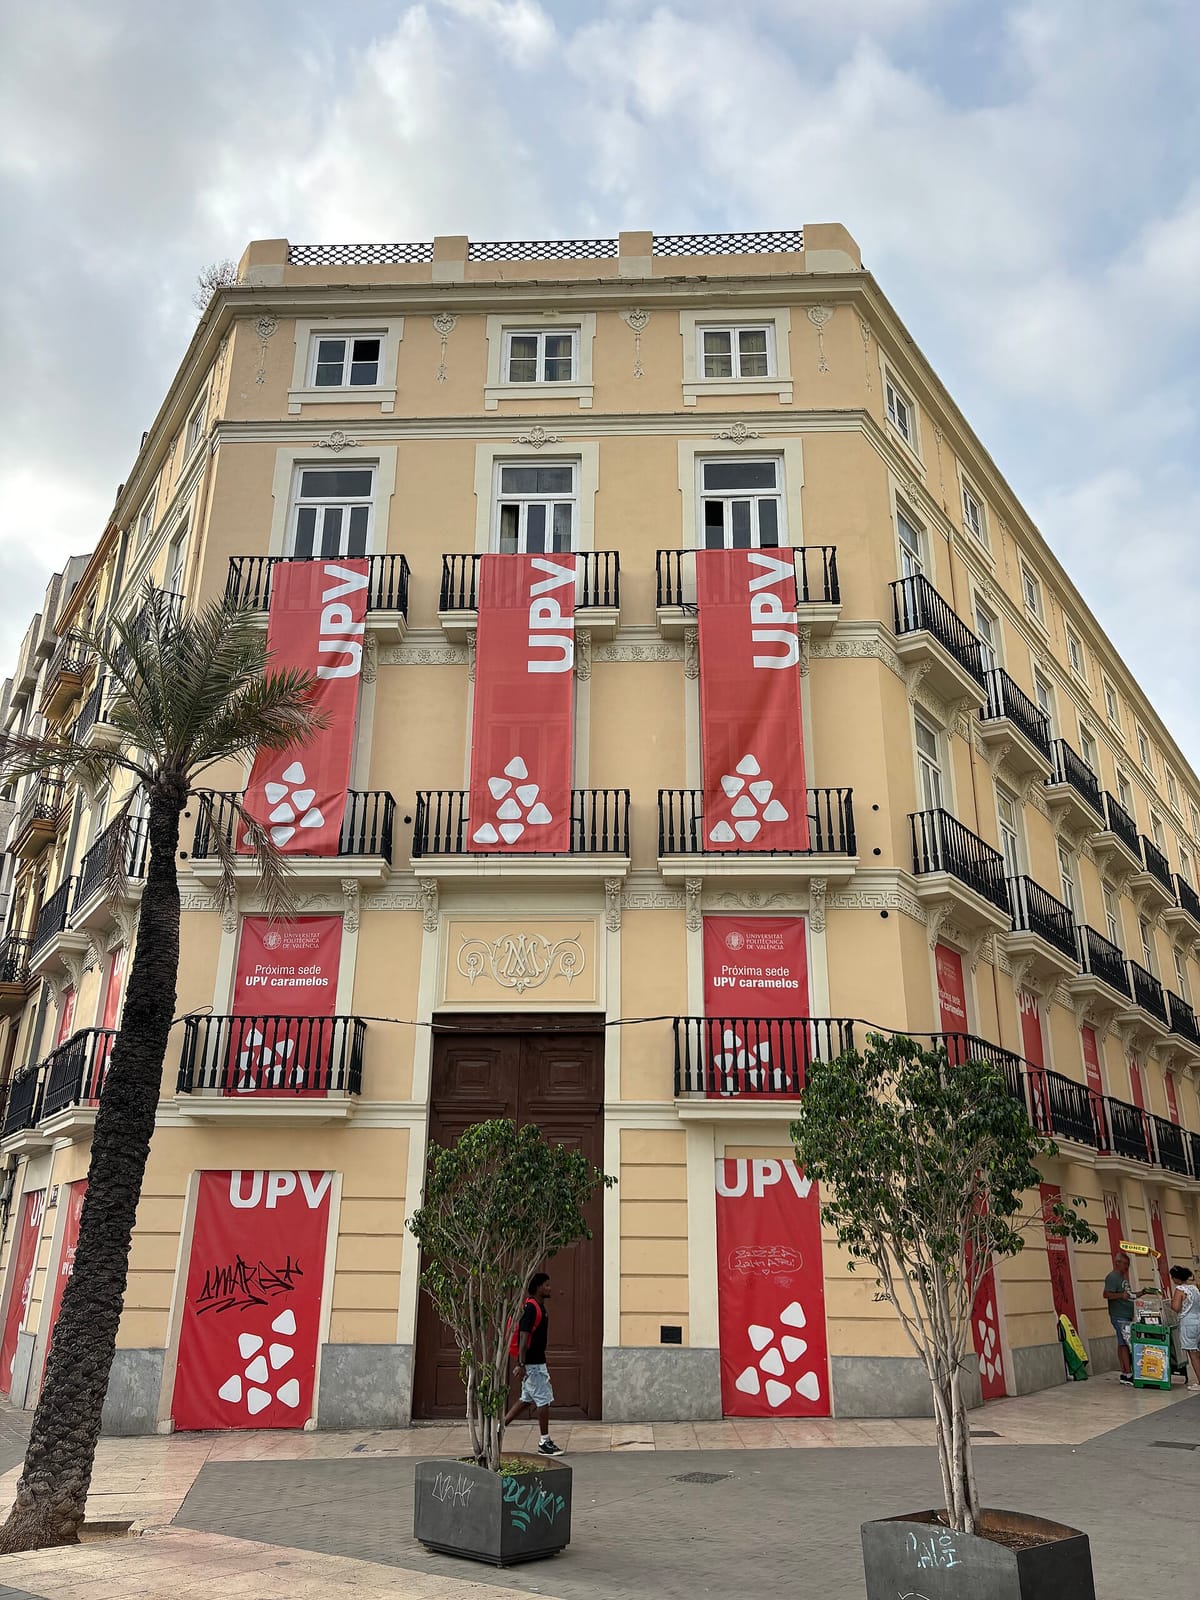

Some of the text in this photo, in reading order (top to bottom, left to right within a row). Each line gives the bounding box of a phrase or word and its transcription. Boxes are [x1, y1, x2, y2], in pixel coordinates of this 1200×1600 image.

[316, 564, 369, 680] UPV
[527, 558, 576, 674] UPV
[747, 552, 800, 669] UPV
[245, 976, 329, 987] UPV caramelos
[255, 964, 321, 975] Próxima sede
[713, 976, 799, 989] UPV caramelos
[721, 965, 790, 977] Próxima sede
[229, 1170, 334, 1209] UPV
